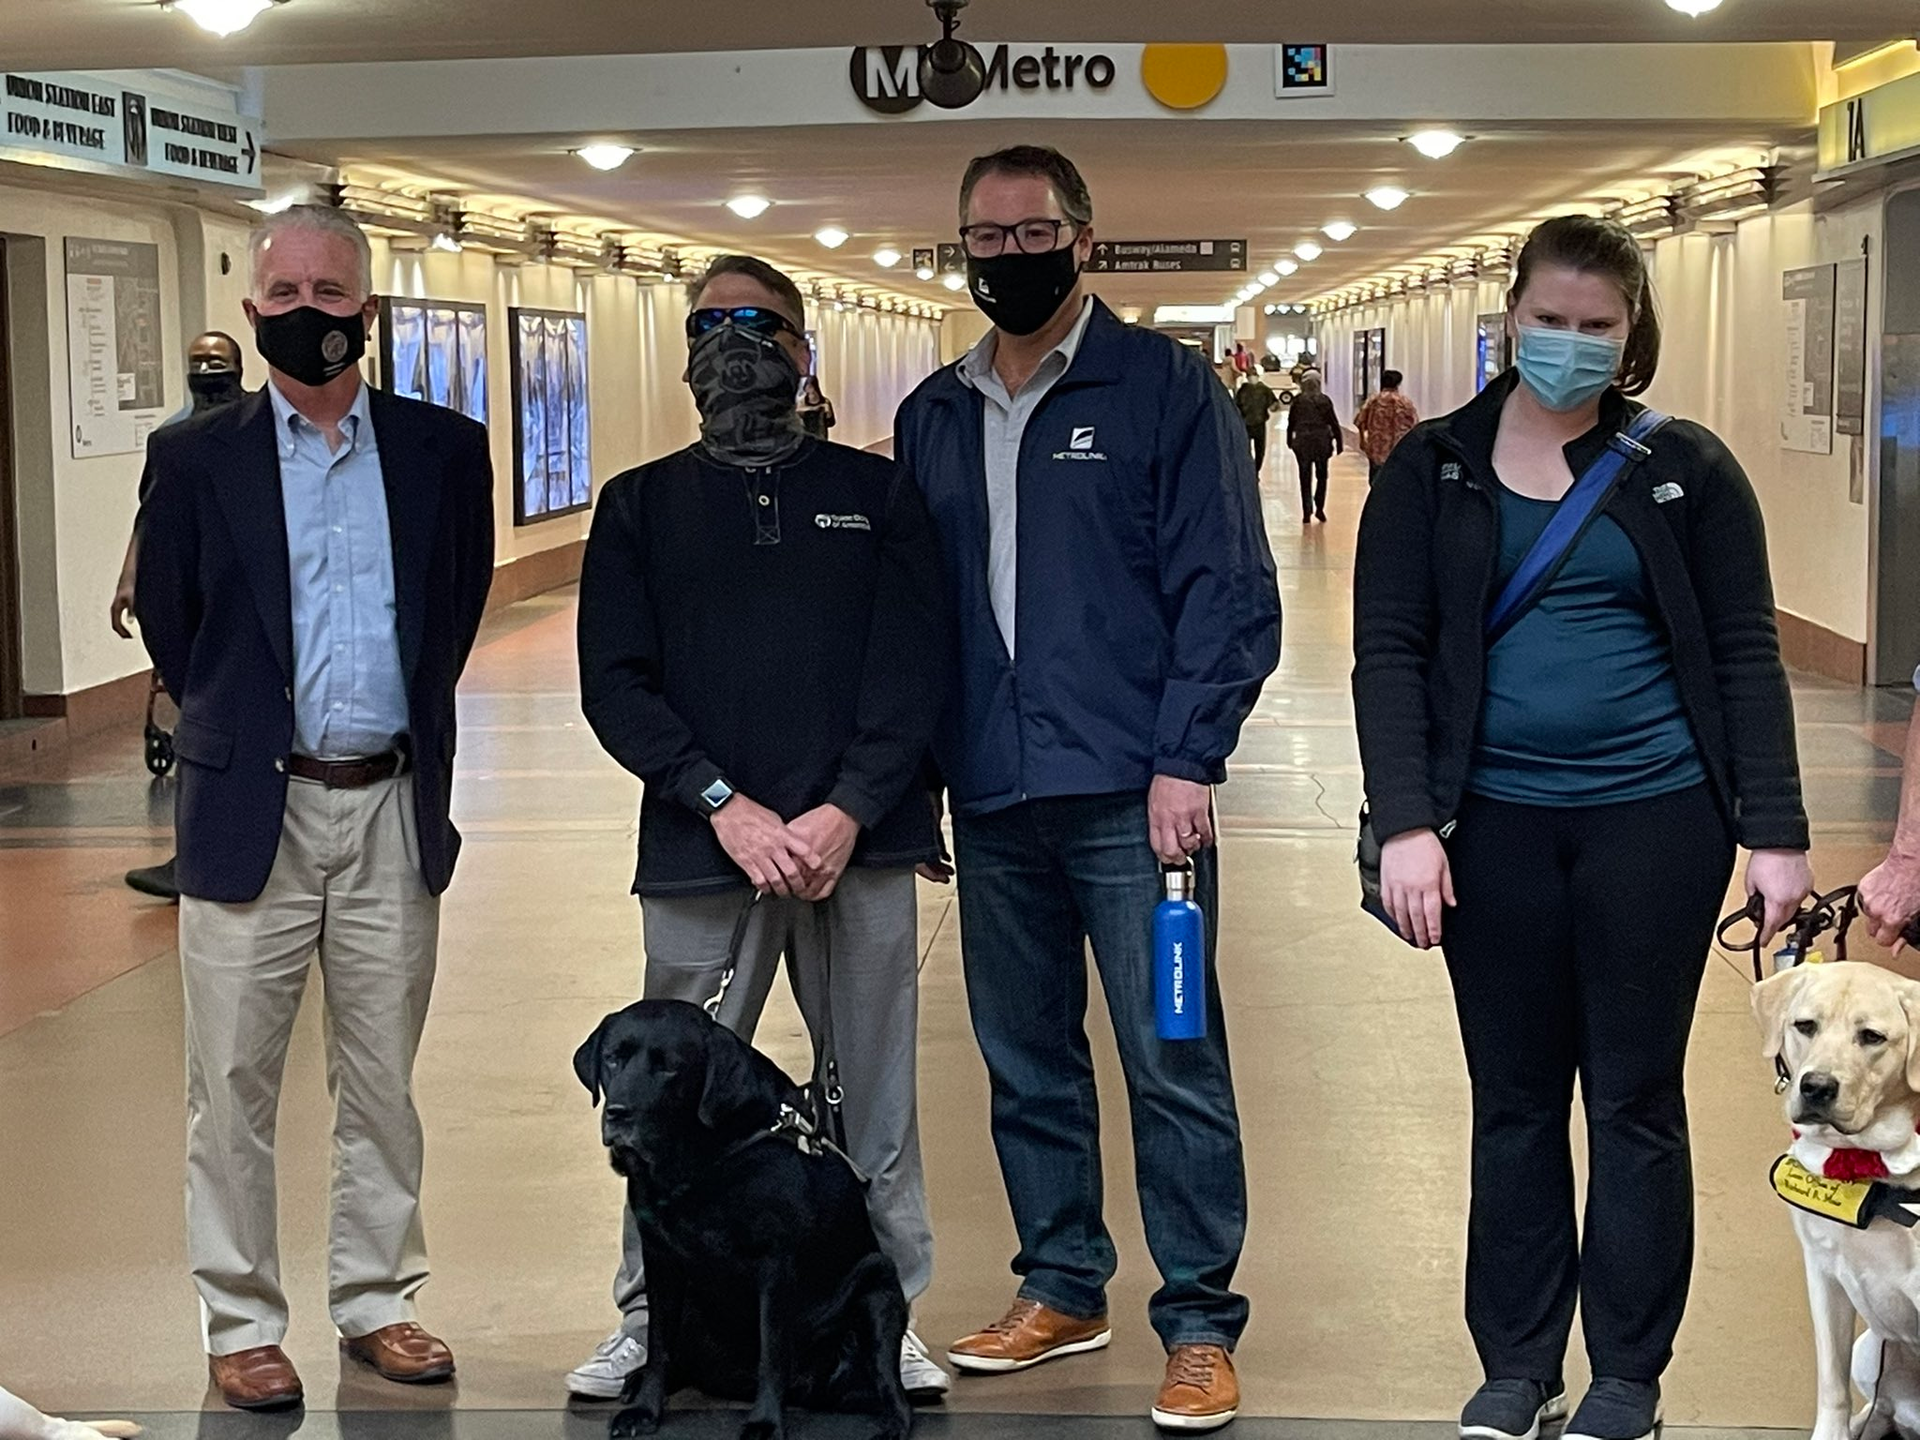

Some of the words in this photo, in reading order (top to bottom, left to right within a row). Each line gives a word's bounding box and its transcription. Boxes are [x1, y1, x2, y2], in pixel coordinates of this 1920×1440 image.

[45, 83, 90, 112] STATION
[91, 93, 116, 117] EAST
[8, 112, 40, 138] FOOD
[1173, 942, 1184, 1014] METROLINK
